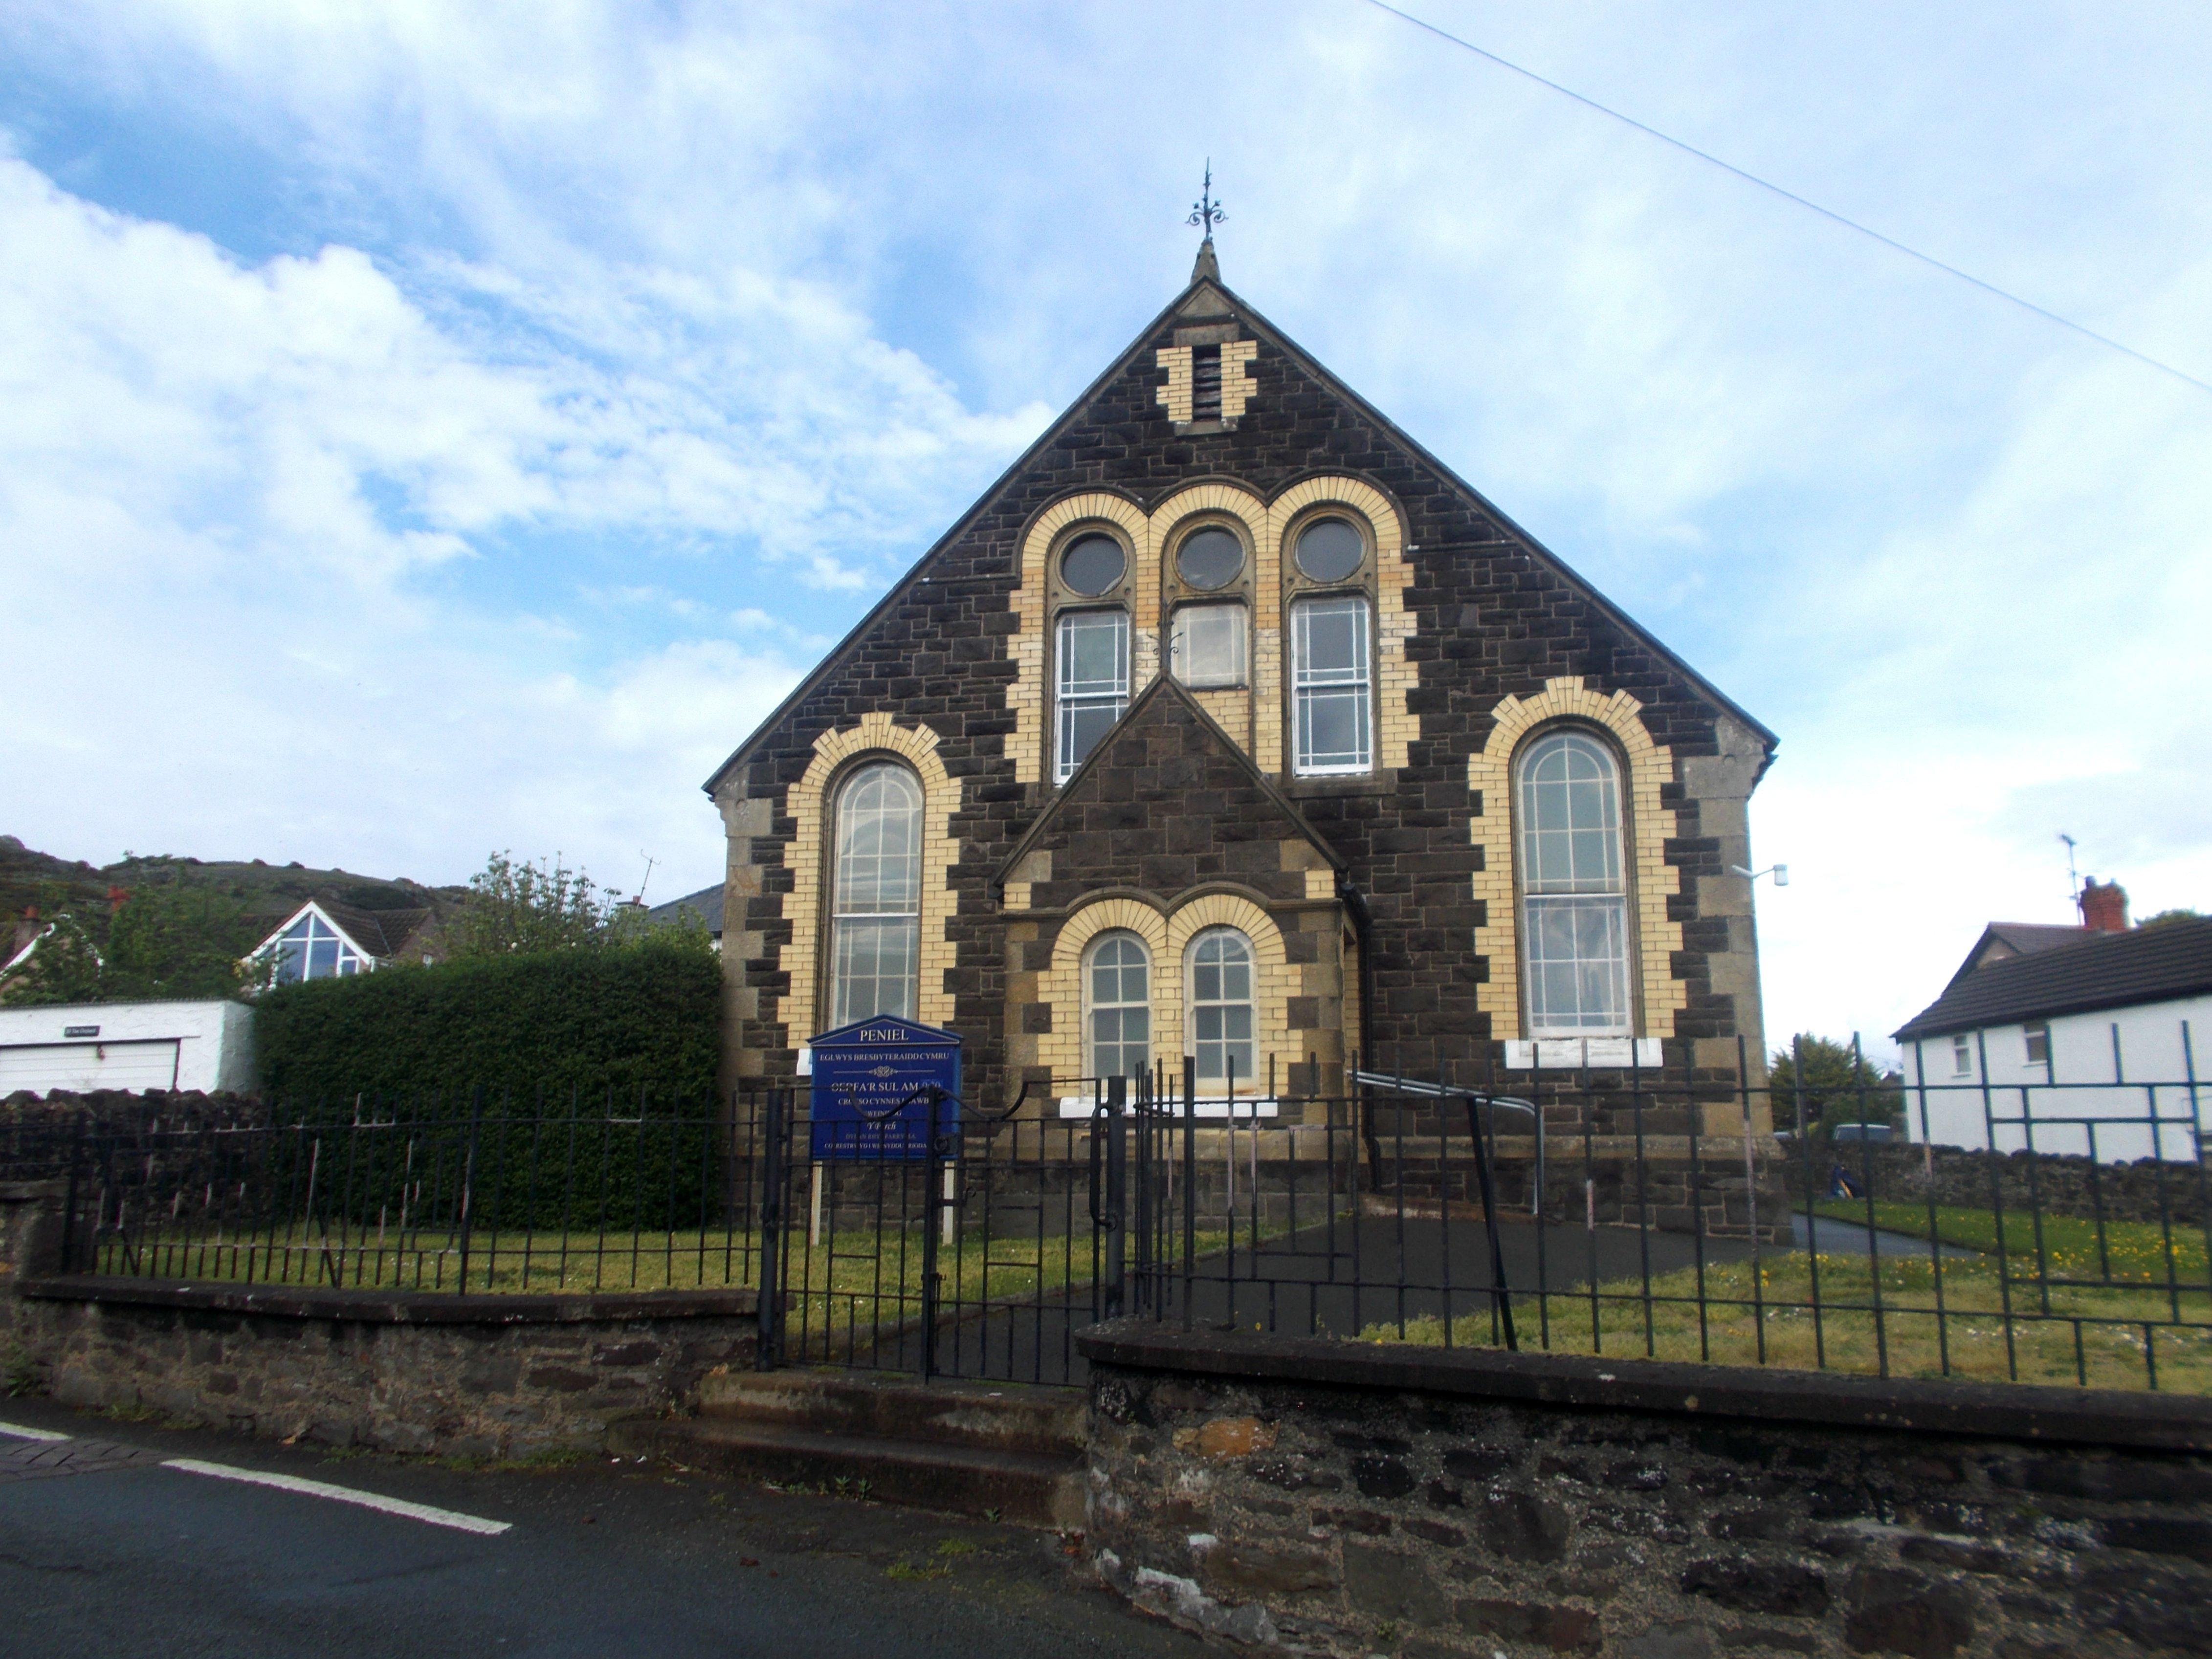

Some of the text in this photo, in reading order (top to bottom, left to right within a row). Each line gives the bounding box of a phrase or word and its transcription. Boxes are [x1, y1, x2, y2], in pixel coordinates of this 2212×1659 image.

[860, 1028, 909, 1041] PENIEL
[878, 1082, 899, 1091] SUL
[901, 1082, 918, 1091] AM
